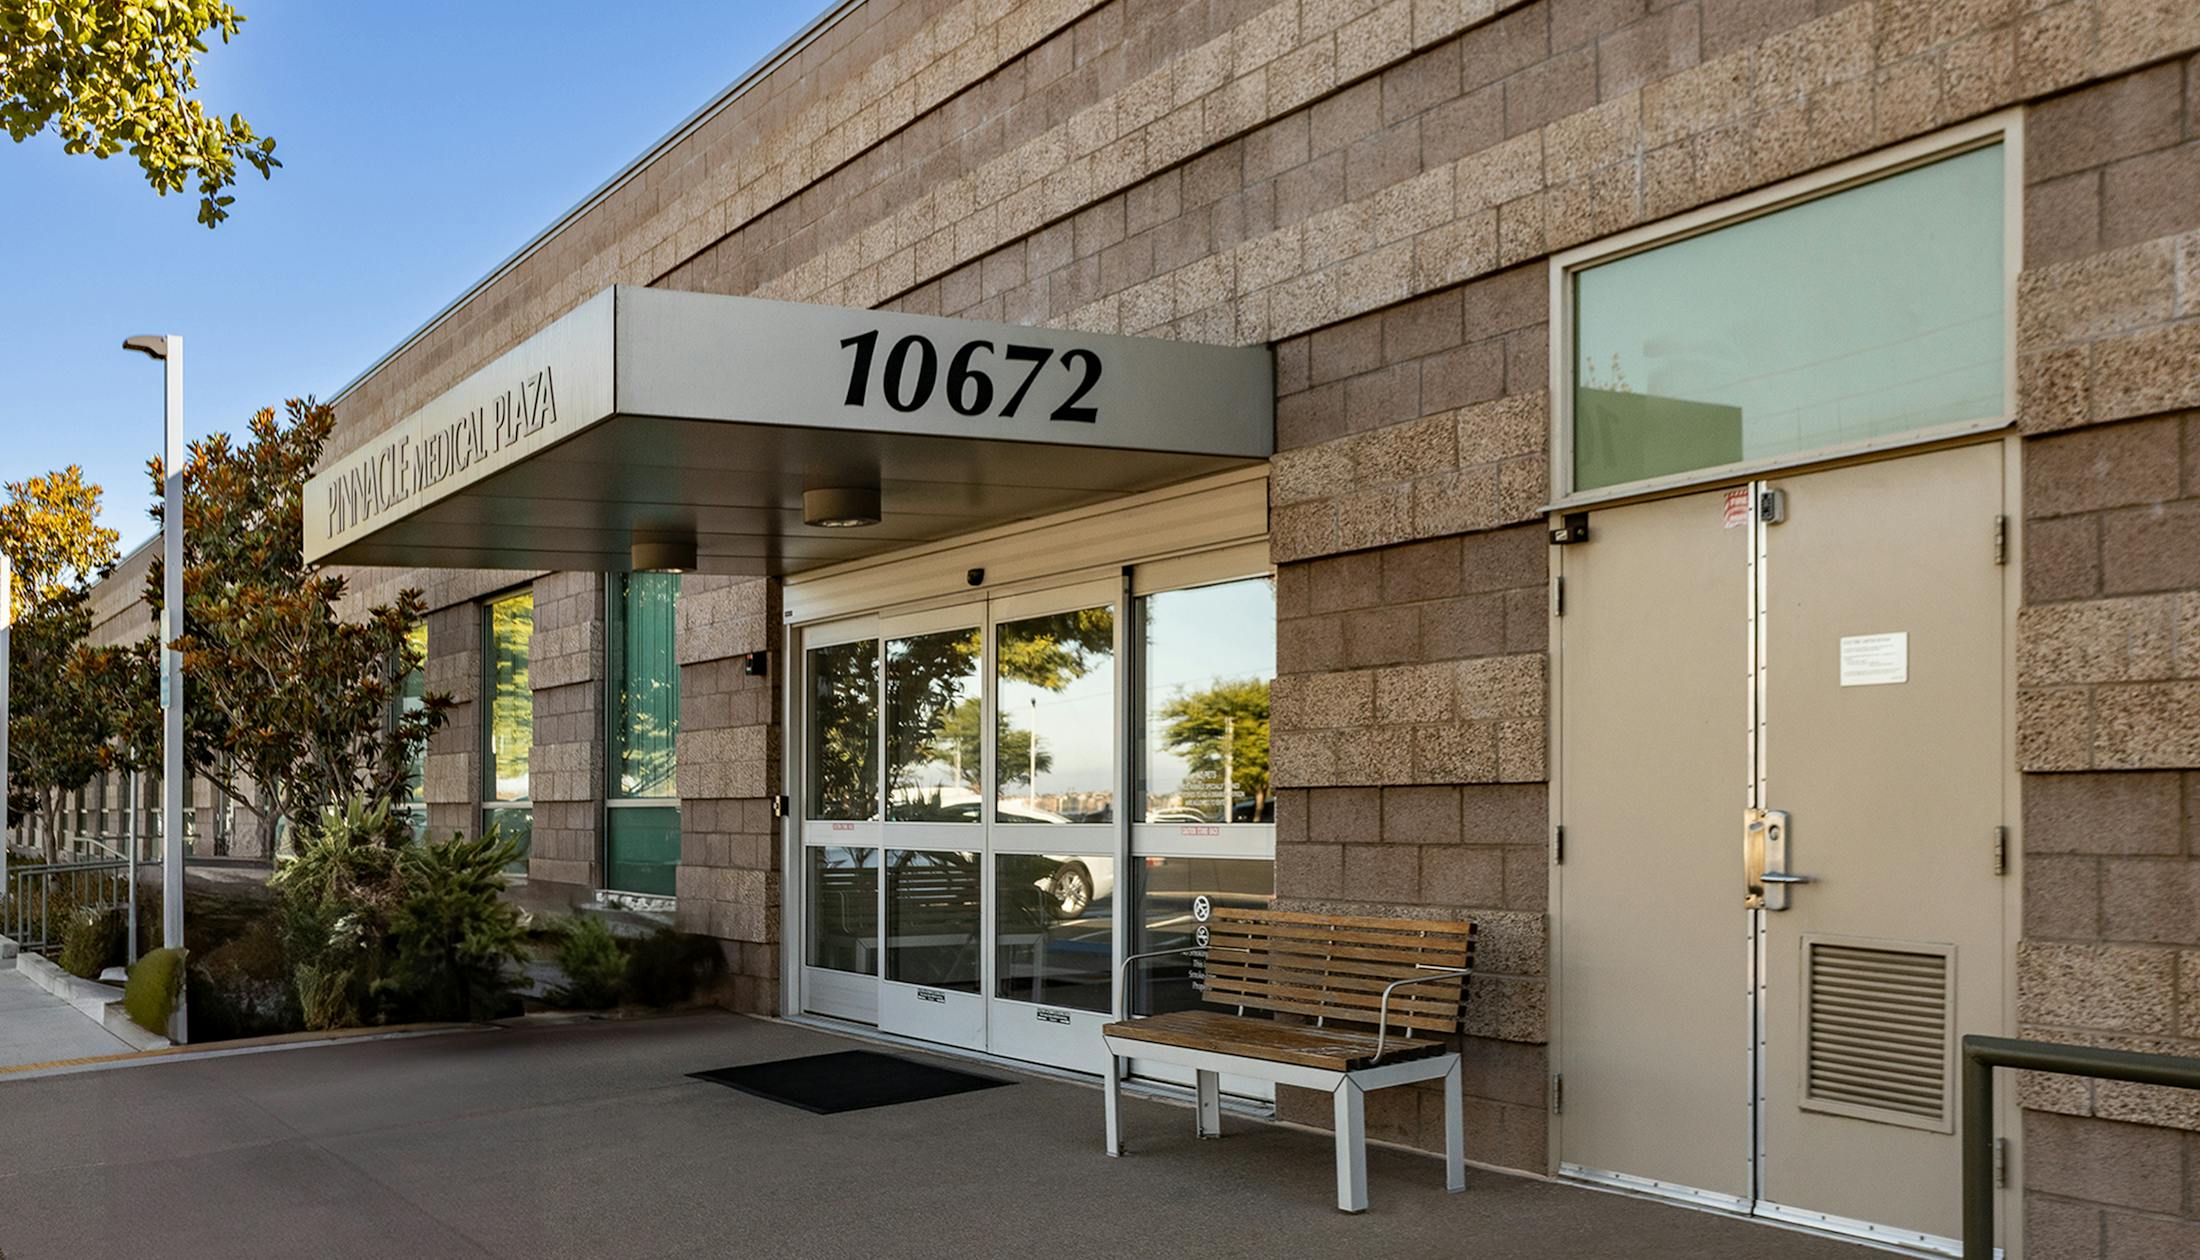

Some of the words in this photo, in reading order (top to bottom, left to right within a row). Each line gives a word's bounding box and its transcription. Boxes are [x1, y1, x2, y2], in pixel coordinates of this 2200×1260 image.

[840, 329, 1102, 423] 10672
[328, 435, 409, 539] PINNACLE
[412, 406, 488, 496] MEDICAL
[493, 365, 557, 454] PLAZA
